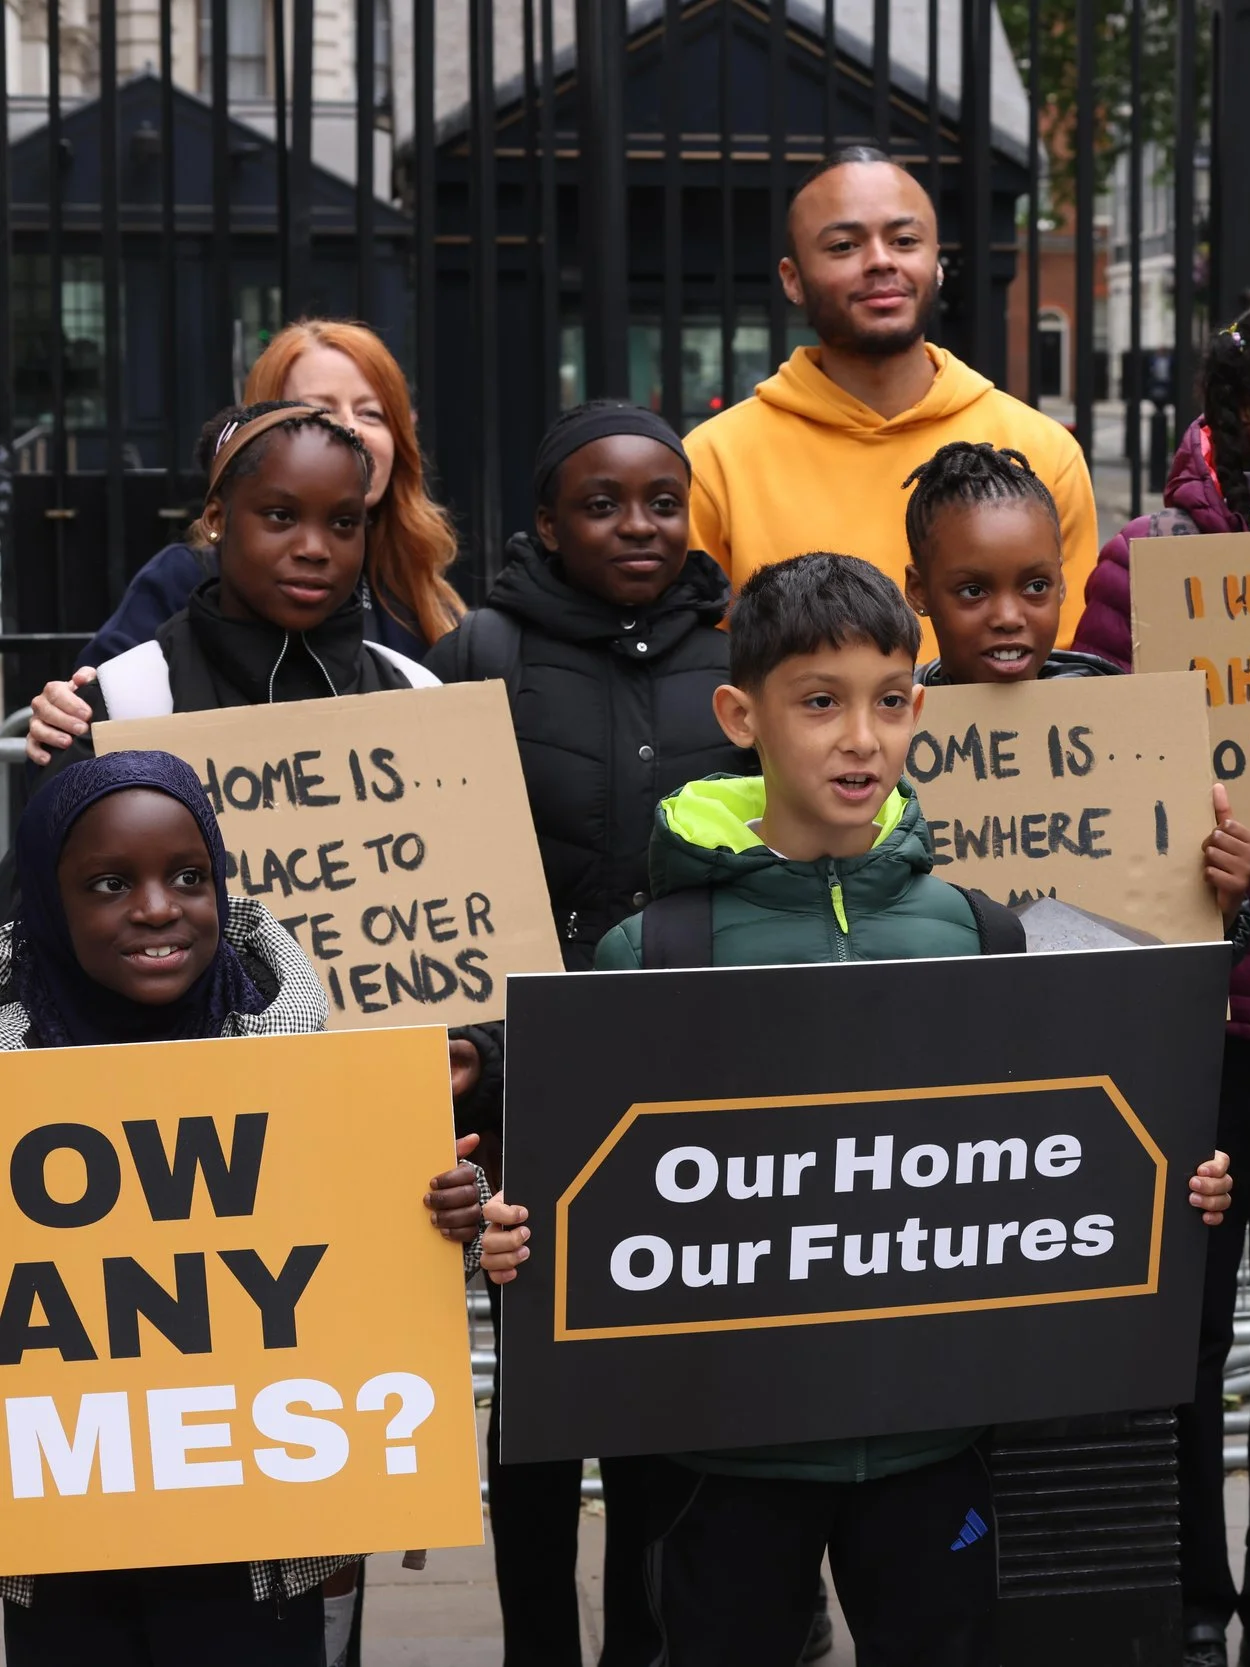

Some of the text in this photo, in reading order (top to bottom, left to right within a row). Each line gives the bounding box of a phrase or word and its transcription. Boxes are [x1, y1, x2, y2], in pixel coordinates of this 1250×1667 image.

[363, 832, 426, 874] TO
[360, 892, 496, 946] OVER
[656, 1135, 1081, 1202] Our Home
[611, 1214, 1113, 1290] Our Futures
